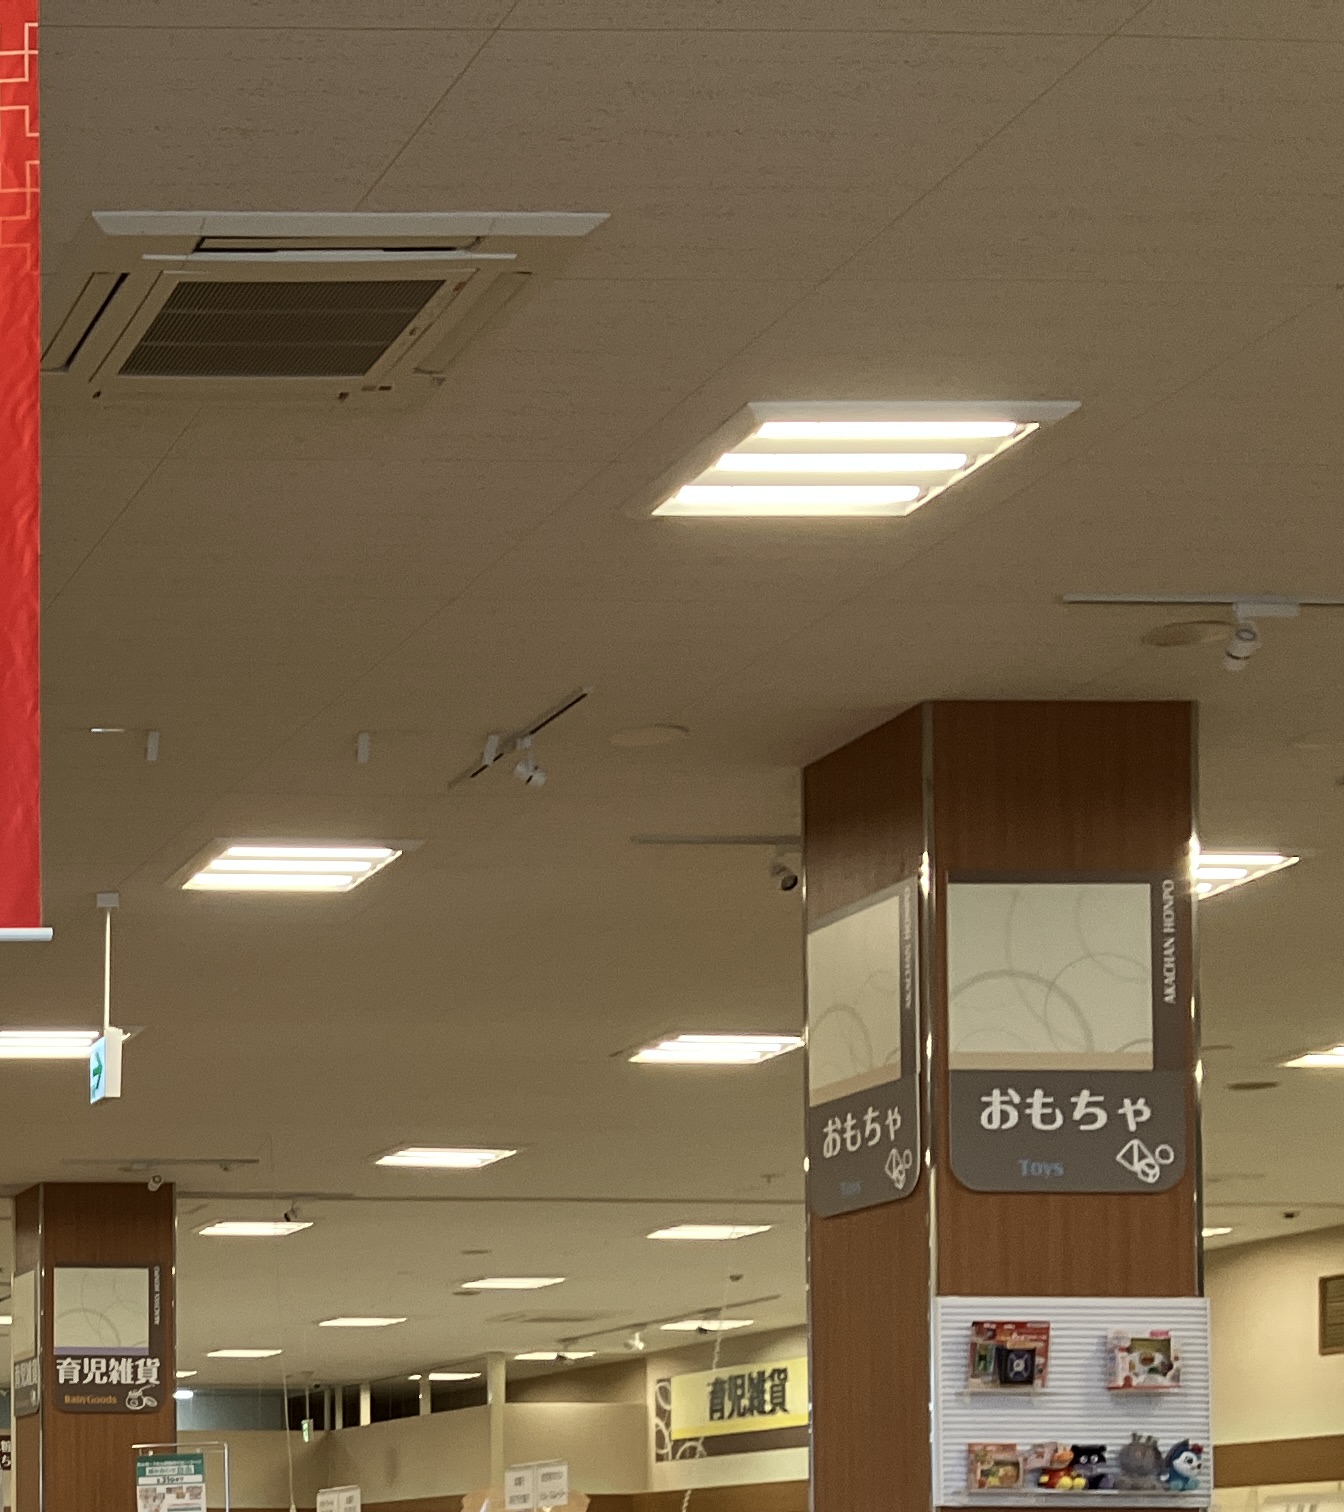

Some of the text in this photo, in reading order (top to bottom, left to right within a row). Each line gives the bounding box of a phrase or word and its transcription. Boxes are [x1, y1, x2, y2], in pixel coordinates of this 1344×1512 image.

[822, 1105, 902, 1159] おもちゃ
[980, 1087, 1152, 1132] おもちゃ
[1019, 1158, 1063, 1178] Toys
[56, 1357, 161, 1385] 育児雑貨
[707, 1367, 790, 1421] 育児雑貨
